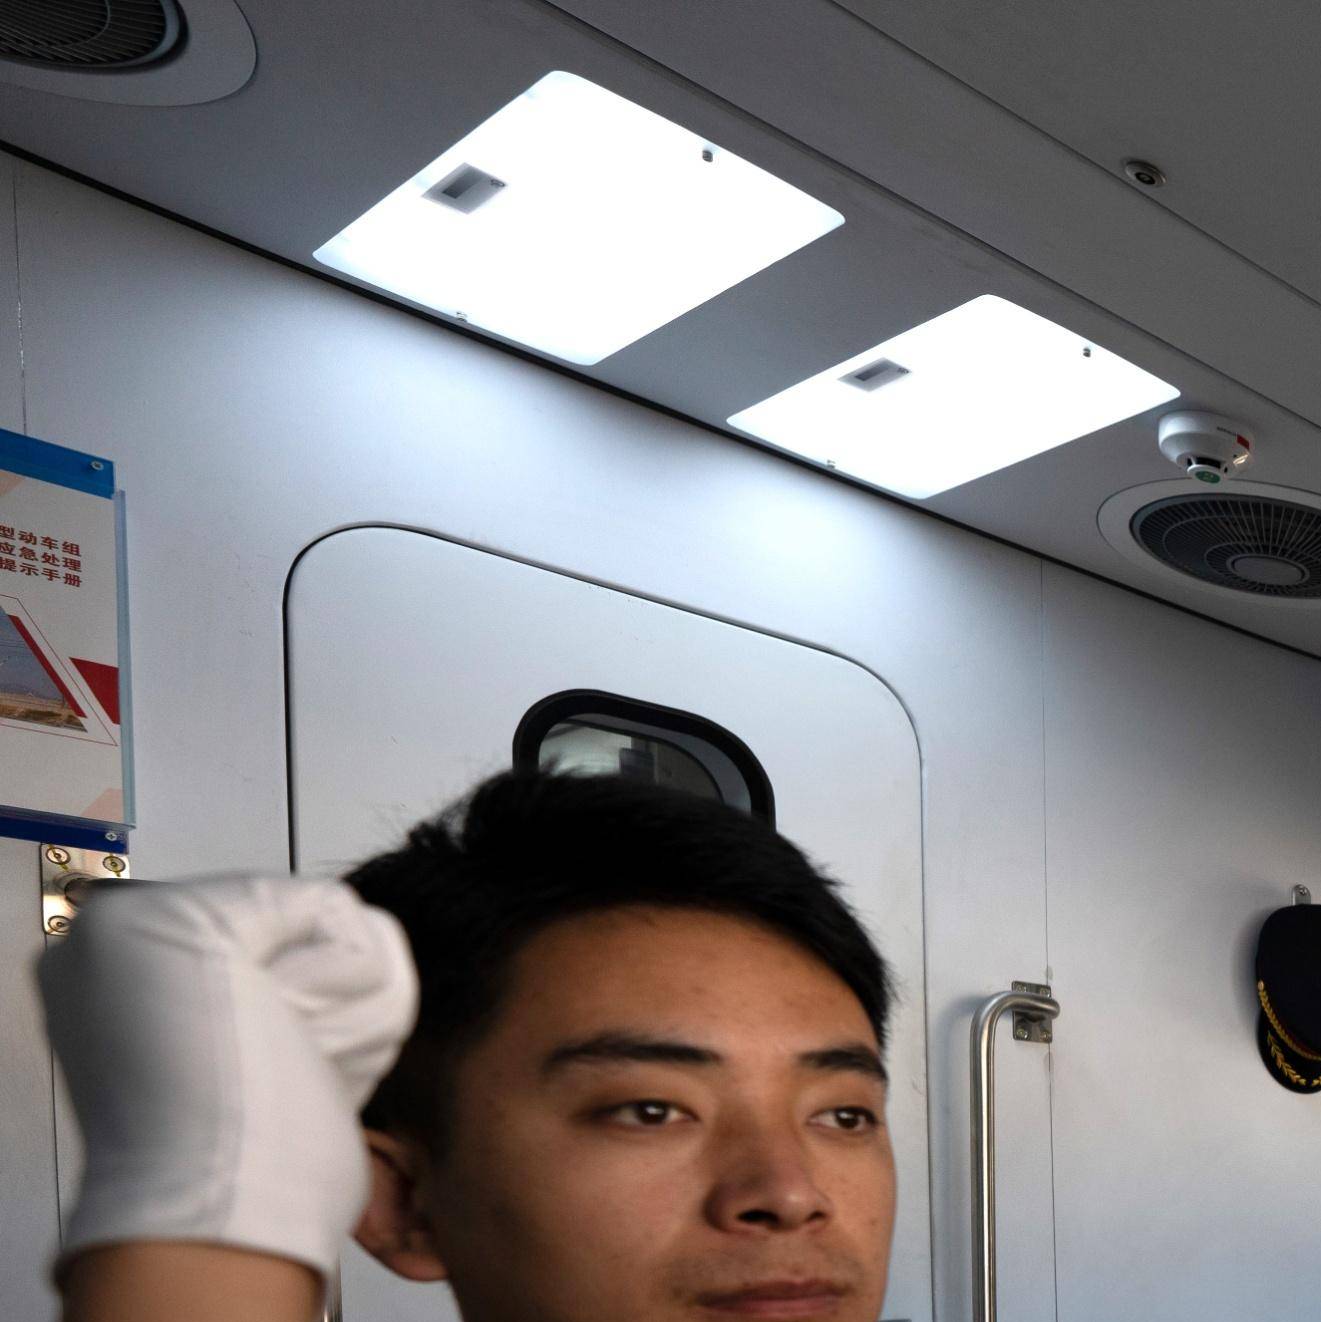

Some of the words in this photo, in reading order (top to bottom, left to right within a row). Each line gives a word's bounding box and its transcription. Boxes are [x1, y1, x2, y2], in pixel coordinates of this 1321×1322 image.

[0, 525, 82, 557] 型动车组
[0, 542, 82, 573] 应急处理
[0, 556, 82, 588] 提示手册
